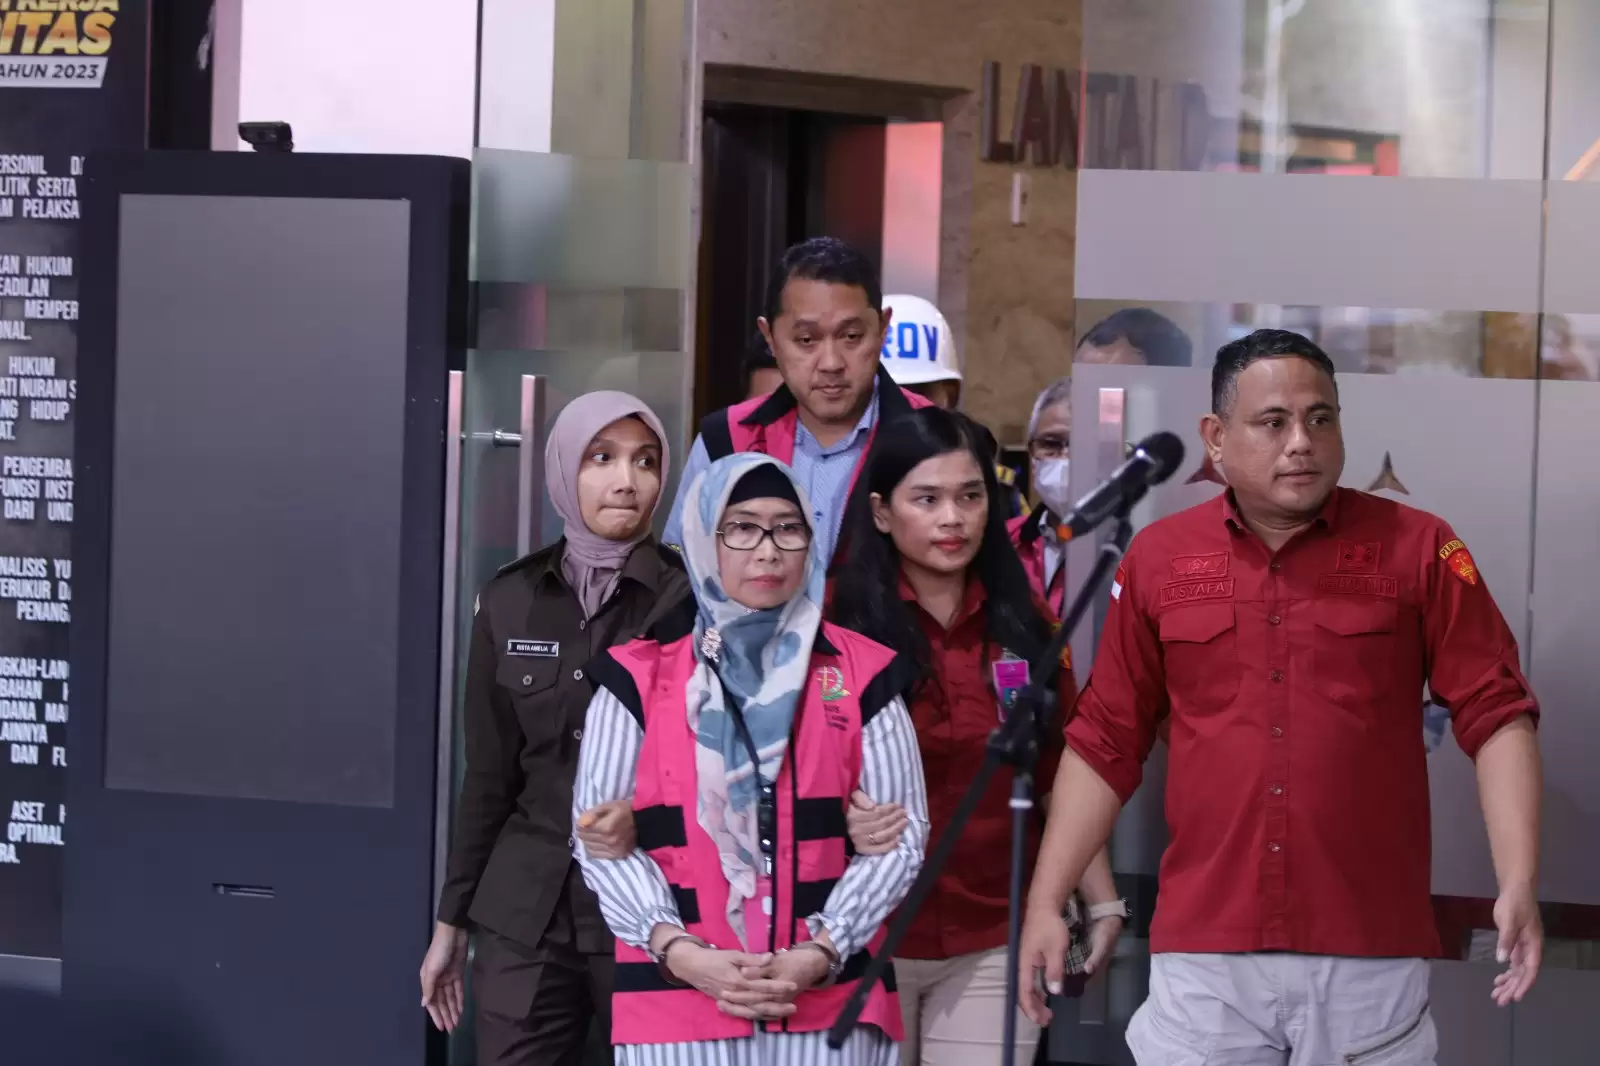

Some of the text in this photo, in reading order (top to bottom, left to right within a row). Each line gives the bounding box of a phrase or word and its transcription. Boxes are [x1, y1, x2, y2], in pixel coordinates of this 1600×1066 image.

[0, 11, 116, 54] ITAS
[52, 64, 99, 79] 2023
[37, 176, 77, 197] SERTA
[22, 197, 80, 219] PELAKSA
[26, 255, 73, 276] HUKUM
[9, 356, 56, 377] HUKUM
[19, 377, 68, 399] NURANI
[30, 399, 70, 421] HIDUP
[3, 455, 73, 478] PENGEMBA
[4, 498, 35, 520] DARI
[16, 599, 72, 623] PENANG
[10, 743, 39, 765] DAN
[10, 799, 46, 822] ASET
[7, 821, 66, 846] OPTIMAL
